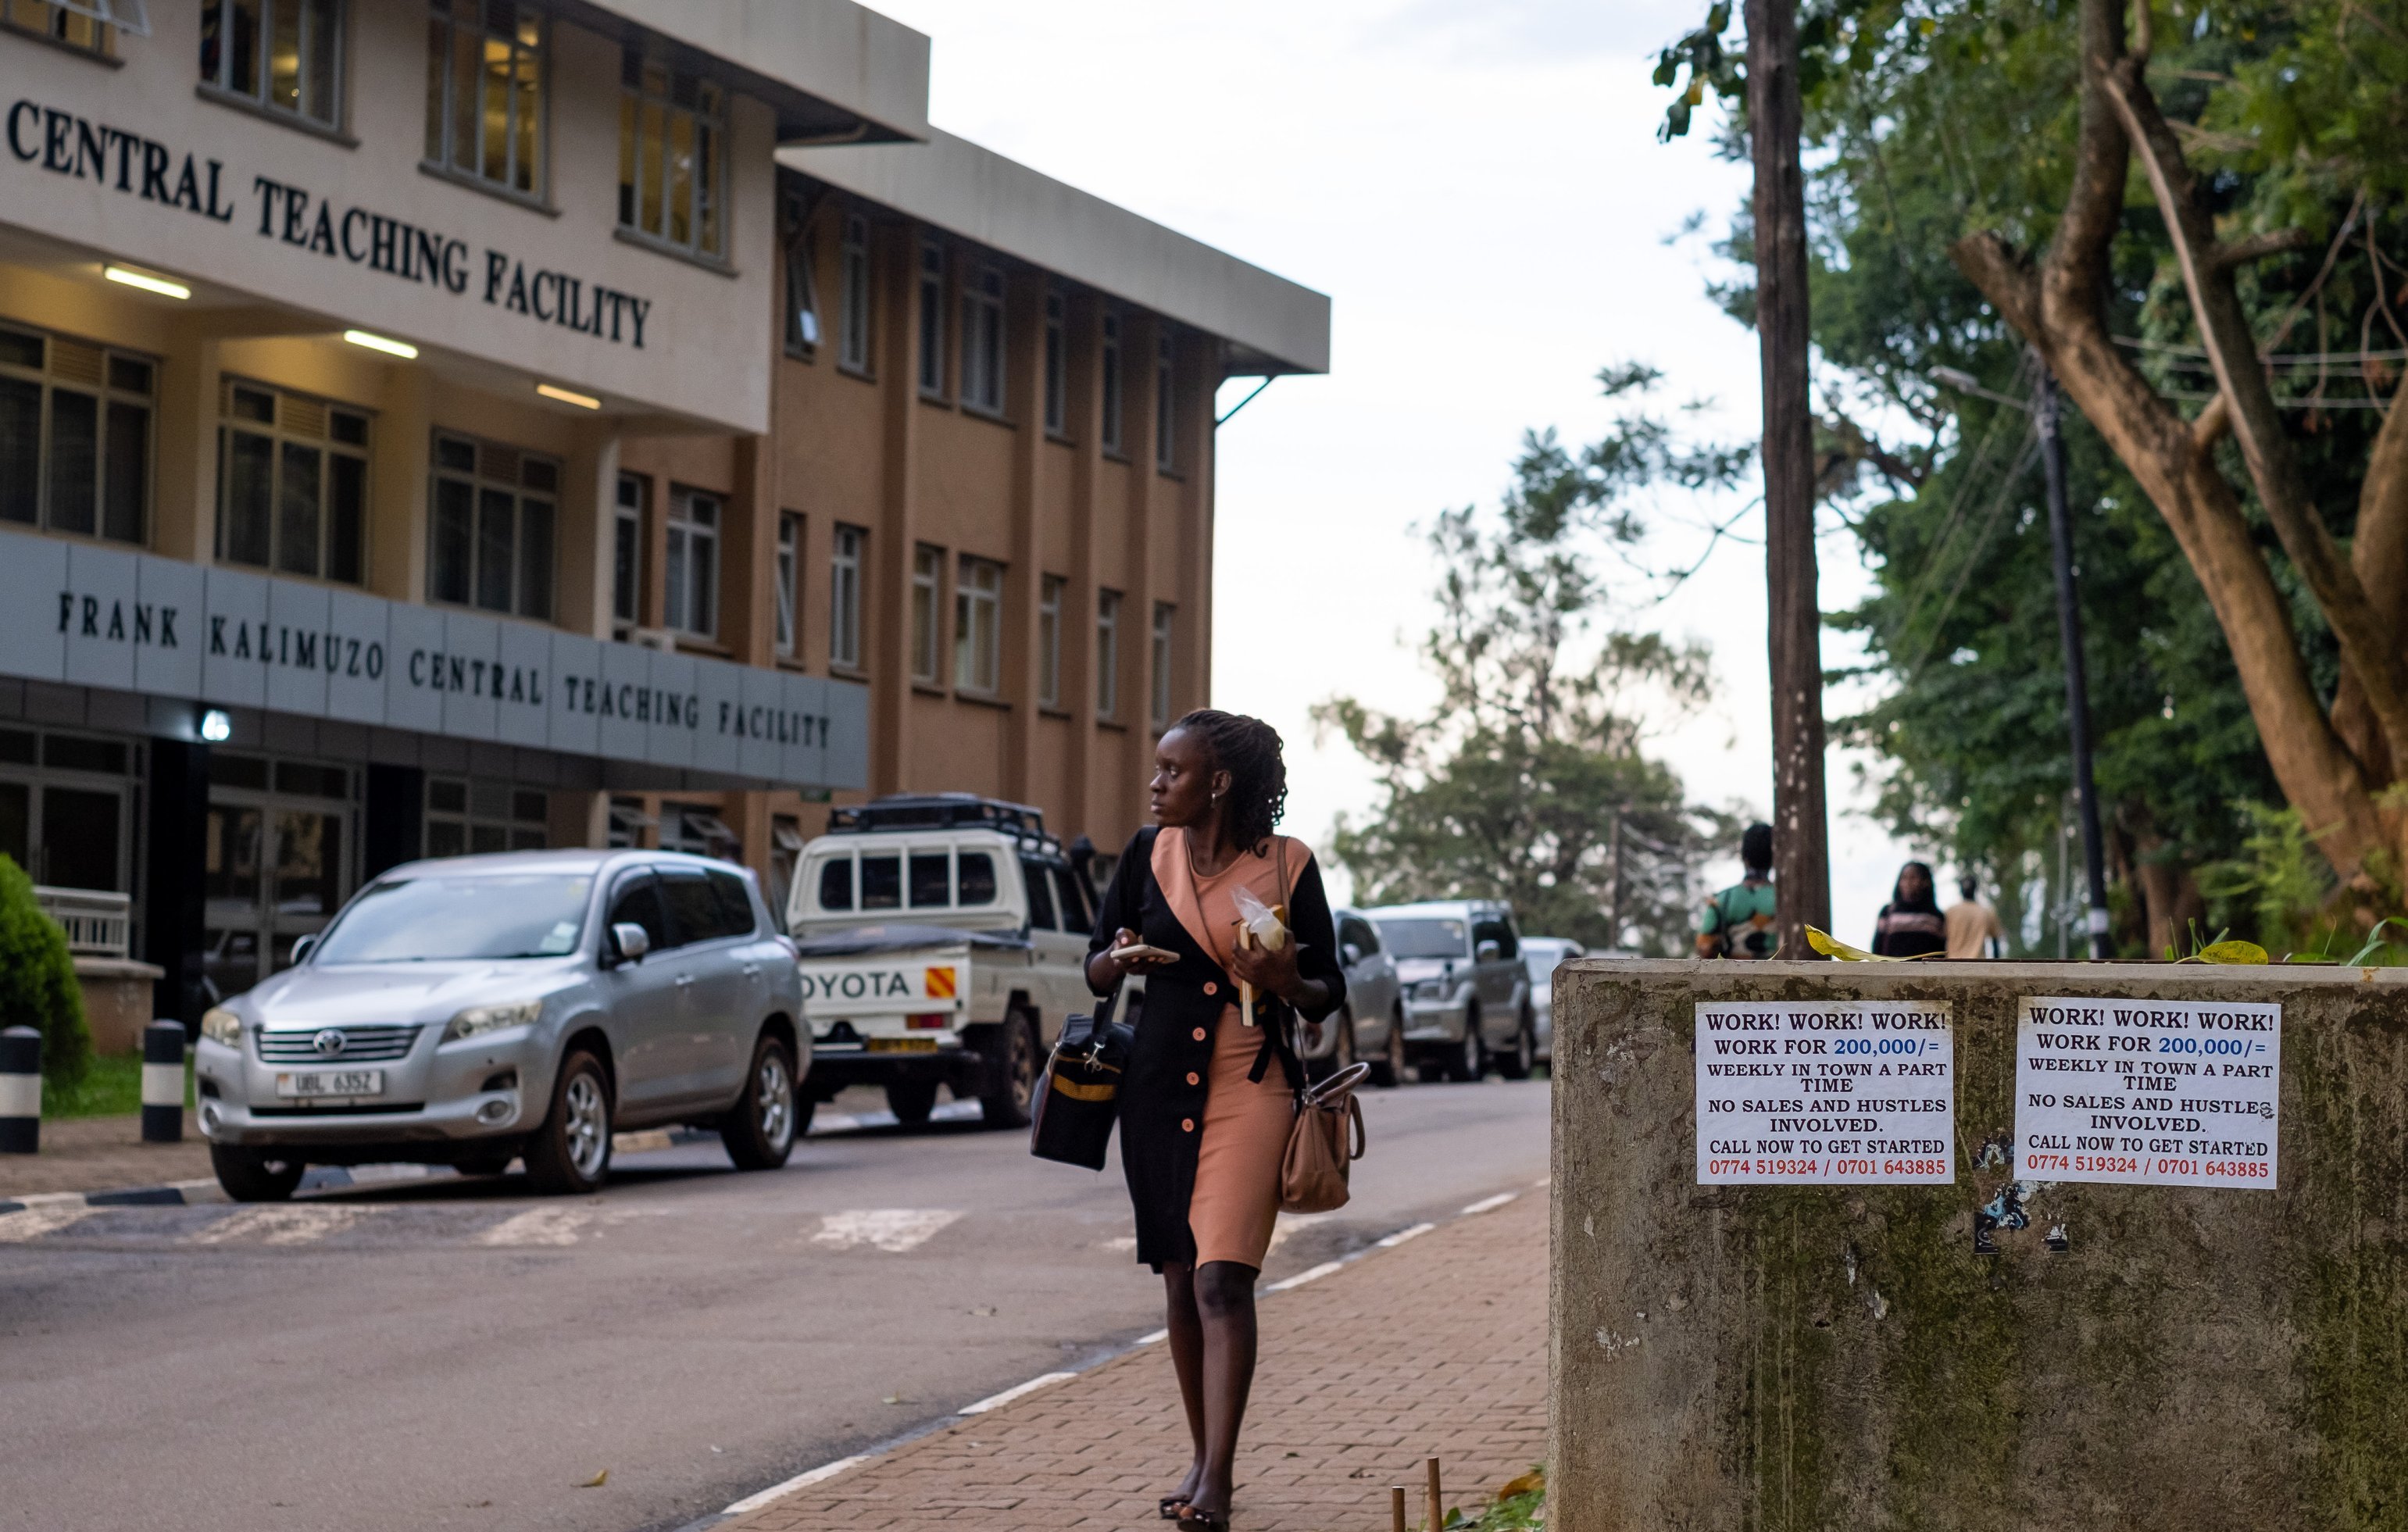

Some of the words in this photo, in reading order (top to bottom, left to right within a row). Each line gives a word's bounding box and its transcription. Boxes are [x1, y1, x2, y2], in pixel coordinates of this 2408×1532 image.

[8, 99, 233, 223] CENTRAL
[254, 177, 469, 295] TEACHING
[484, 249, 652, 348] FACILITY
[59, 592, 178, 648] FRANK
[211, 616, 384, 680] KALIMUZO
[409, 648, 542, 705] CENTRAL
[565, 676, 699, 729] TEACHING
[719, 702, 830, 748] FACILITY
[801, 972, 909, 998] OYOTA
[1706, 1014, 1781, 1030] WORK!
[1789, 1014, 1863, 1030] WORK!
[1872, 1013, 1945, 1030] WORK!
[2029, 1008, 2105, 1026] WORK!
[2113, 1010, 2188, 1028] WORK!
[2199, 1012, 2274, 1031] WORK!
[1715, 1039, 1777, 1054] WORK
[1785, 1040, 1827, 1054] FOR
[1835, 1038, 1939, 1057] 200,000/=
[2037, 1034, 2100, 1051] WORK
[2108, 1036, 2150, 1052] FOR
[2159, 1037, 2266, 1058] 200,000/=
[1707, 1064, 1785, 1076] WEEKLY
[1792, 1064, 1810, 1076] IN
[1817, 1064, 1872, 1076] TOWN
[1878, 1064, 1892, 1076] A
[1898, 1063, 1947, 1076] PART
[2028, 1058, 2108, 1073] WEEKLY
[2115, 1061, 2134, 1073] IN
[2141, 1062, 2197, 1076] TOWN
[2203, 1063, 2217, 1077] A
[2223, 1064, 2273, 1078] PART
[1801, 1079, 1853, 1092] TIME
[2124, 1077, 2177, 1091] TIME
[1709, 1100, 1735, 1112] NO
[1742, 1100, 1802, 1112] SALES
[1810, 1100, 1850, 1112] AND
[1856, 1100, 1946, 1112] HUSTLES
[2028, 1095, 2056, 1107] NO
[2063, 1095, 2125, 1109] SALES
[2132, 1098, 2173, 1111] AND
[2180, 1099, 2274, 1116] HUSTLES
[1770, 1119, 1884, 1132] INVOLVED.
[2091, 1116, 2206, 1133] INVOLVED.
[1710, 1140, 1751, 1153] CALL
[1757, 1140, 1794, 1153] NOW
[1801, 1140, 1821, 1153] TO
[1828, 1140, 1861, 1153] GET
[1867, 1140, 1944, 1153] STARTED
[2028, 1135, 2070, 1149] CALL
[2077, 1136, 2114, 1151] NOW
[2121, 1138, 2142, 1152] TO
[2149, 1139, 2183, 1153] GET
[2189, 1141, 2267, 1156] STARTED
[1710, 1160, 1750, 1174] 0774
[1756, 1160, 1817, 1174] 519324
[1824, 1159, 1831, 1177] /
[1838, 1160, 1877, 1174] 0701
[1885, 1160, 1945, 1174] 643885
[2028, 1155, 2069, 1170] 0774
[2075, 1156, 2137, 1173] 519324
[2144, 1158, 2151, 1175] /
[2158, 1159, 2199, 1175] 0701
[2206, 1161, 2268, 1178] 643885
